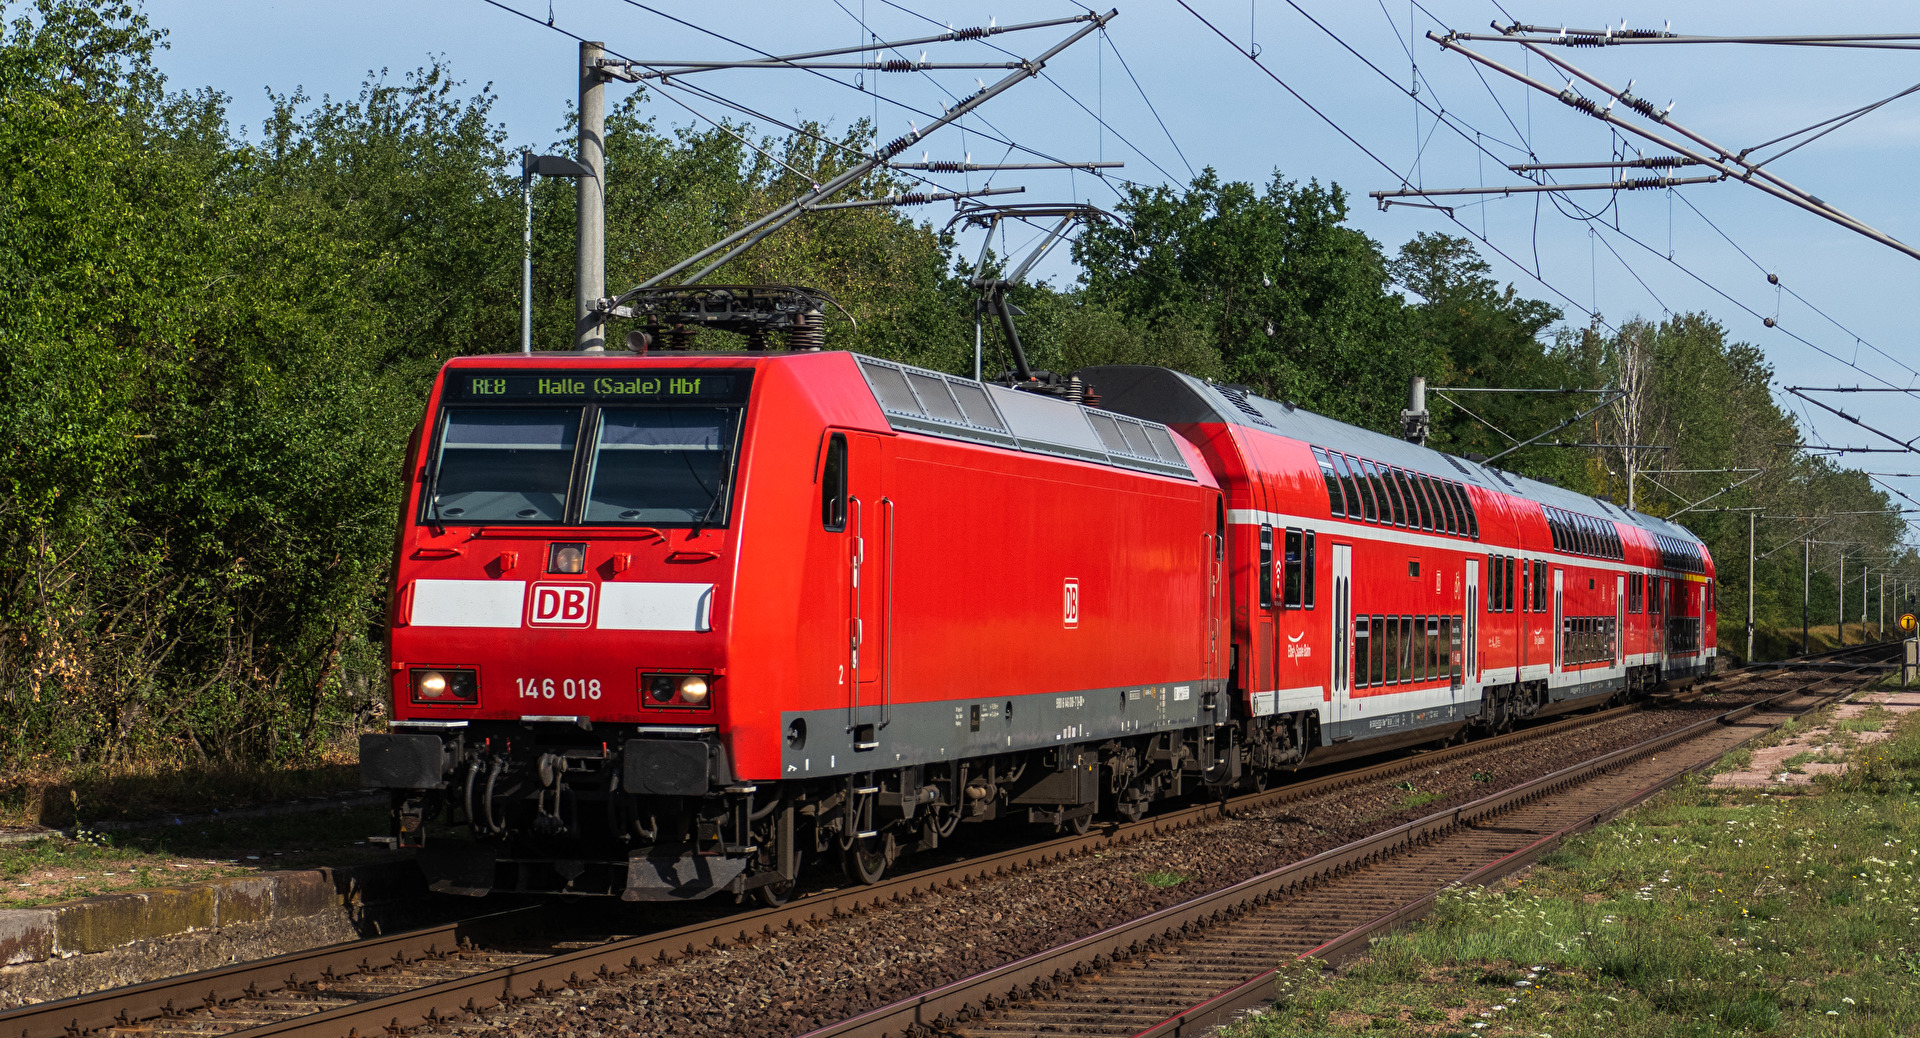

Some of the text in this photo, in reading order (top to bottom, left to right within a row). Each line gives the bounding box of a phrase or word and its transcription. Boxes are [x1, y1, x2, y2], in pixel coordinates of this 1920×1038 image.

[472, 377, 701, 395] RE8 Halle (Saale) Hbf
[535, 588, 586, 621] DB
[1065, 585, 1078, 621] DB
[838, 664, 844, 685] 2
[516, 677, 602, 700] 146 018
